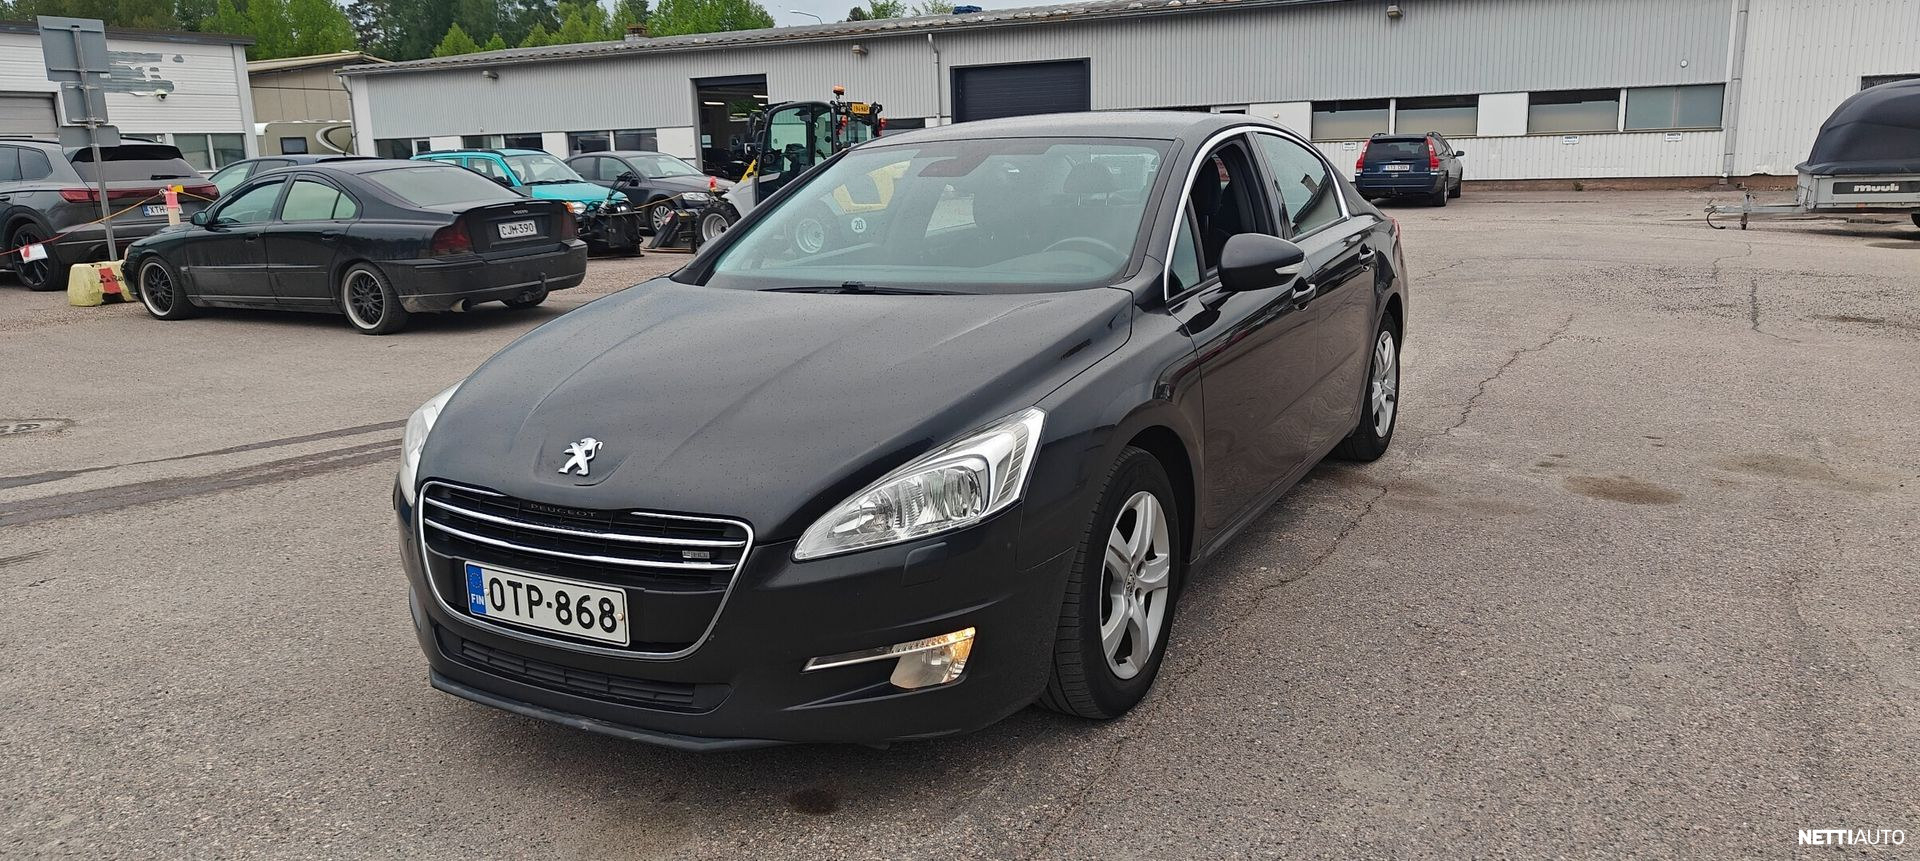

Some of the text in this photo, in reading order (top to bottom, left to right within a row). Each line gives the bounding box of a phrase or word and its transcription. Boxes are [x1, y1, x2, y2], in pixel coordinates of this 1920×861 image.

[501, 222, 534, 236] CJM-390
[530, 503, 597, 517] PEUGEOT
[471, 593, 485, 605] FIN
[488, 577, 617, 634] OTP-868
